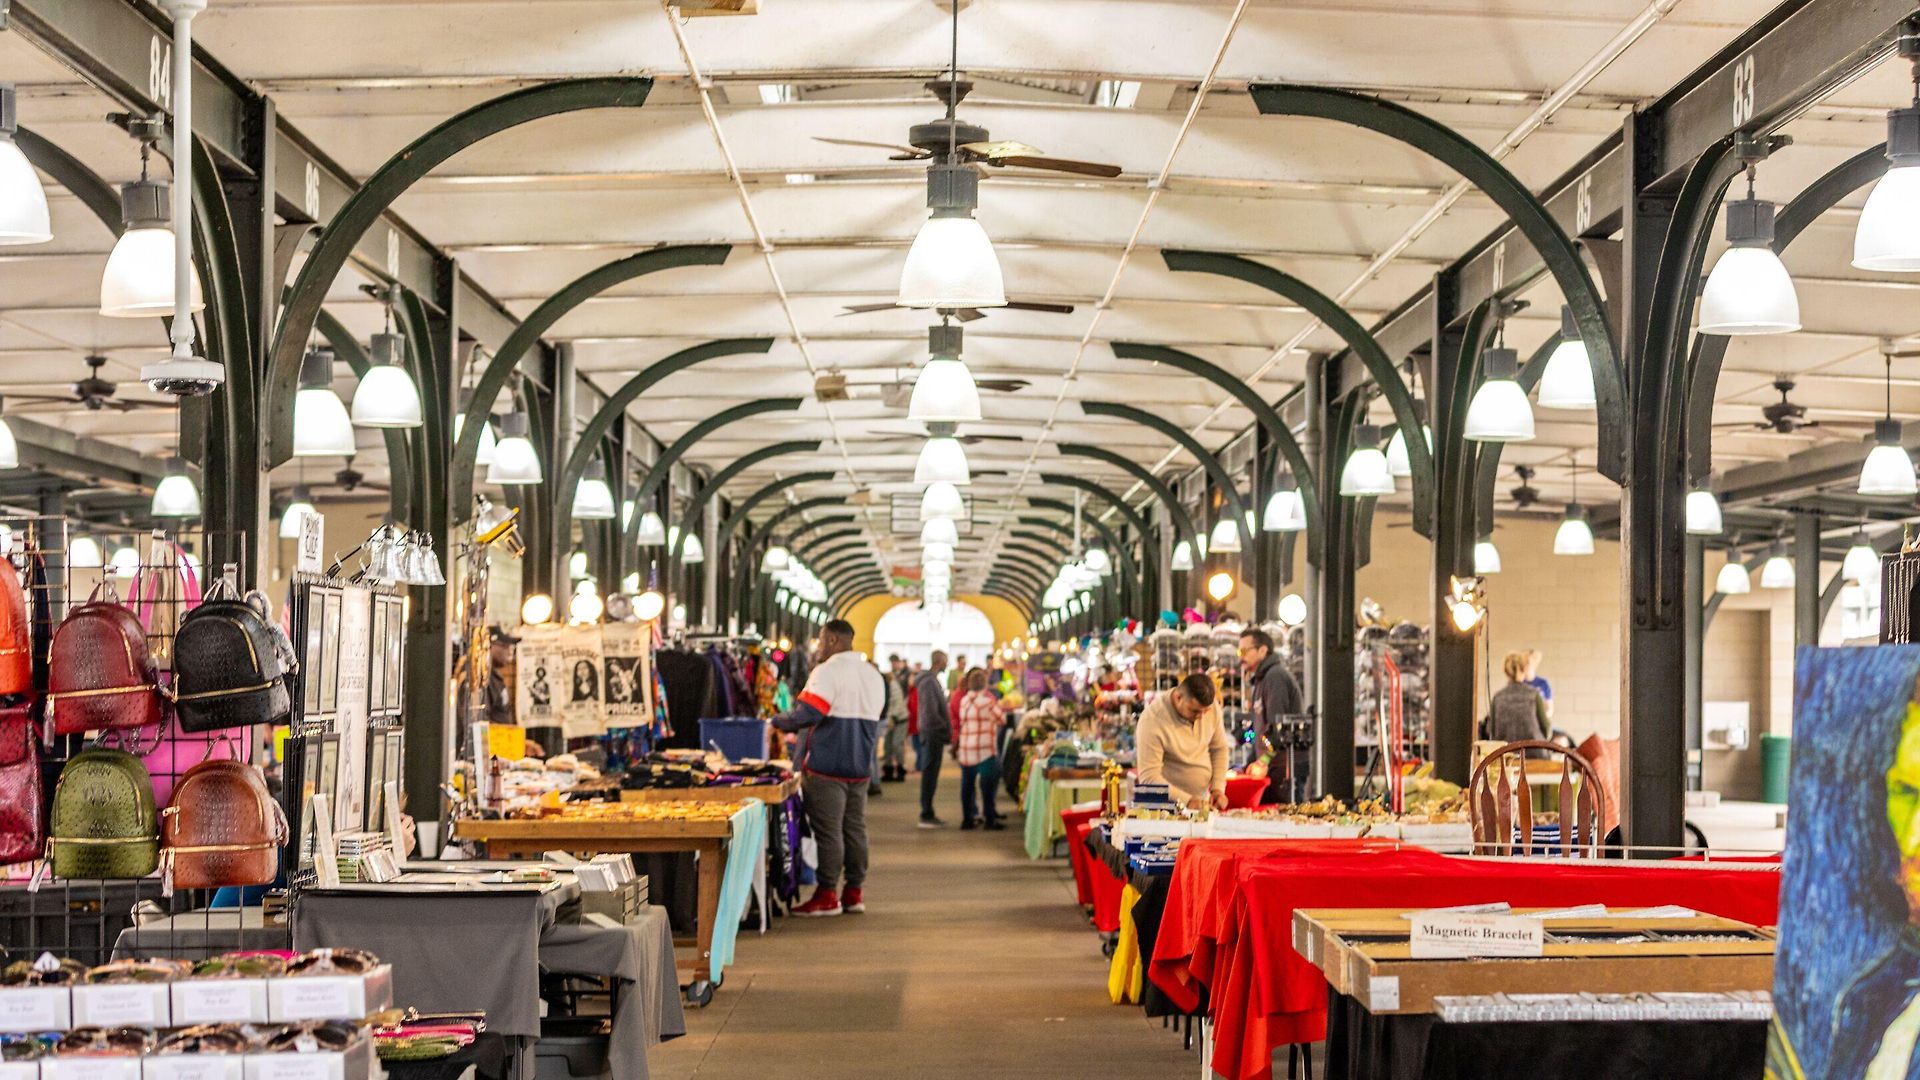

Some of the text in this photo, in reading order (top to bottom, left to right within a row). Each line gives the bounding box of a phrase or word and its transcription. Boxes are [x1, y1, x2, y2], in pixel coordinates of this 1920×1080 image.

[150, 35, 170, 109] 84
[1733, 54, 1754, 128] 83
[305, 161, 319, 220] 86
[1577, 174, 1591, 233] 85
[604, 703, 646, 716] PRINCE
[1422, 925, 1533, 940] Magnetic Bracelet
